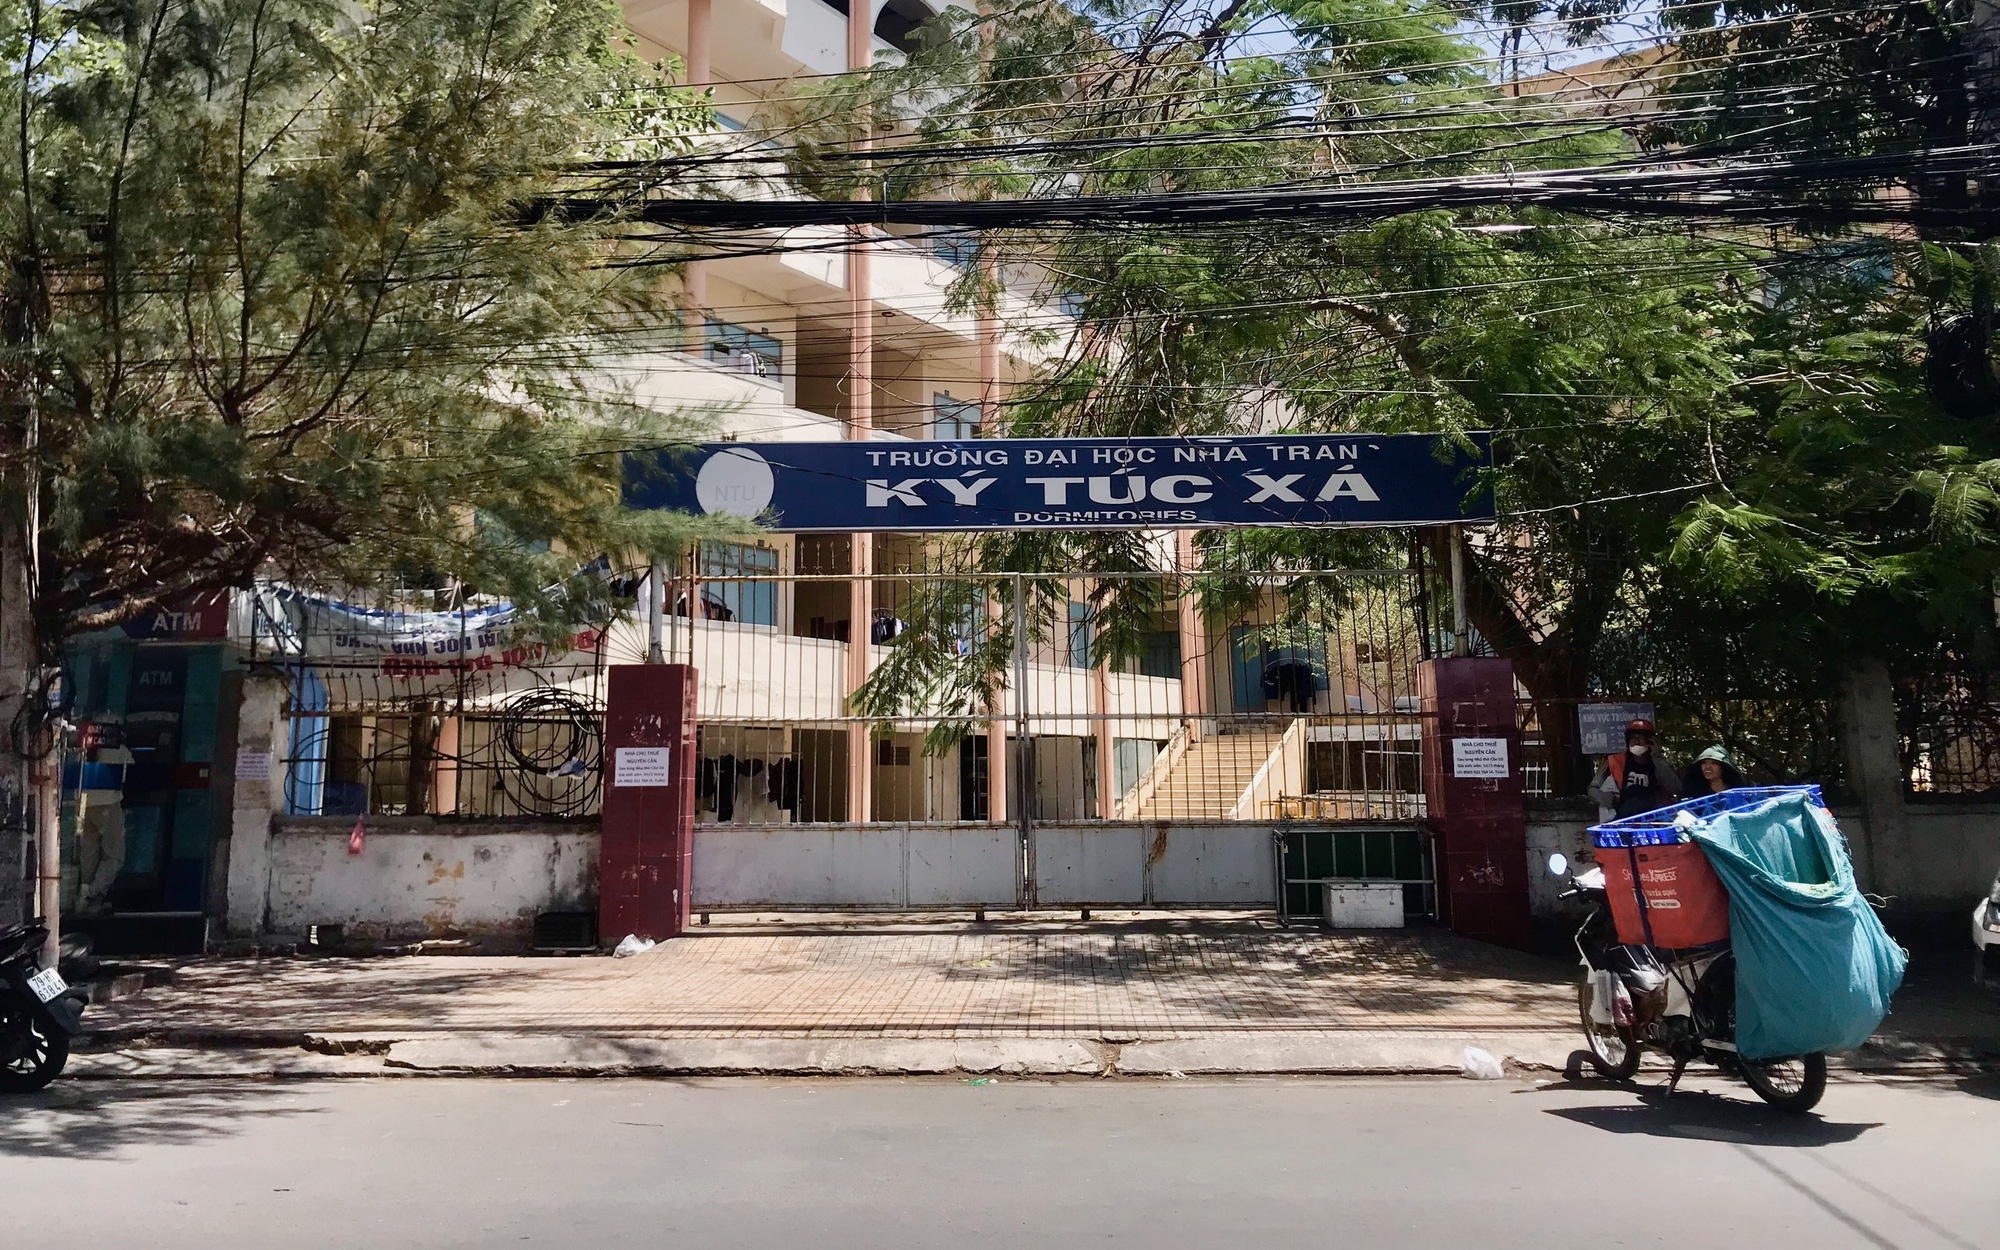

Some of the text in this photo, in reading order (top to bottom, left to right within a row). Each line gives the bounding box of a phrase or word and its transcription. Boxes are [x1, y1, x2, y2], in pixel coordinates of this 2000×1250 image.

[865, 444, 1380, 468] TRƯỜNG ĐẠI HỌC NHA TRAN
[714, 485, 756, 502] NTU
[865, 464, 1382, 507] KÝ TÚC XÁ
[152, 611, 202, 631] ATM
[138, 671, 173, 686] ATM
